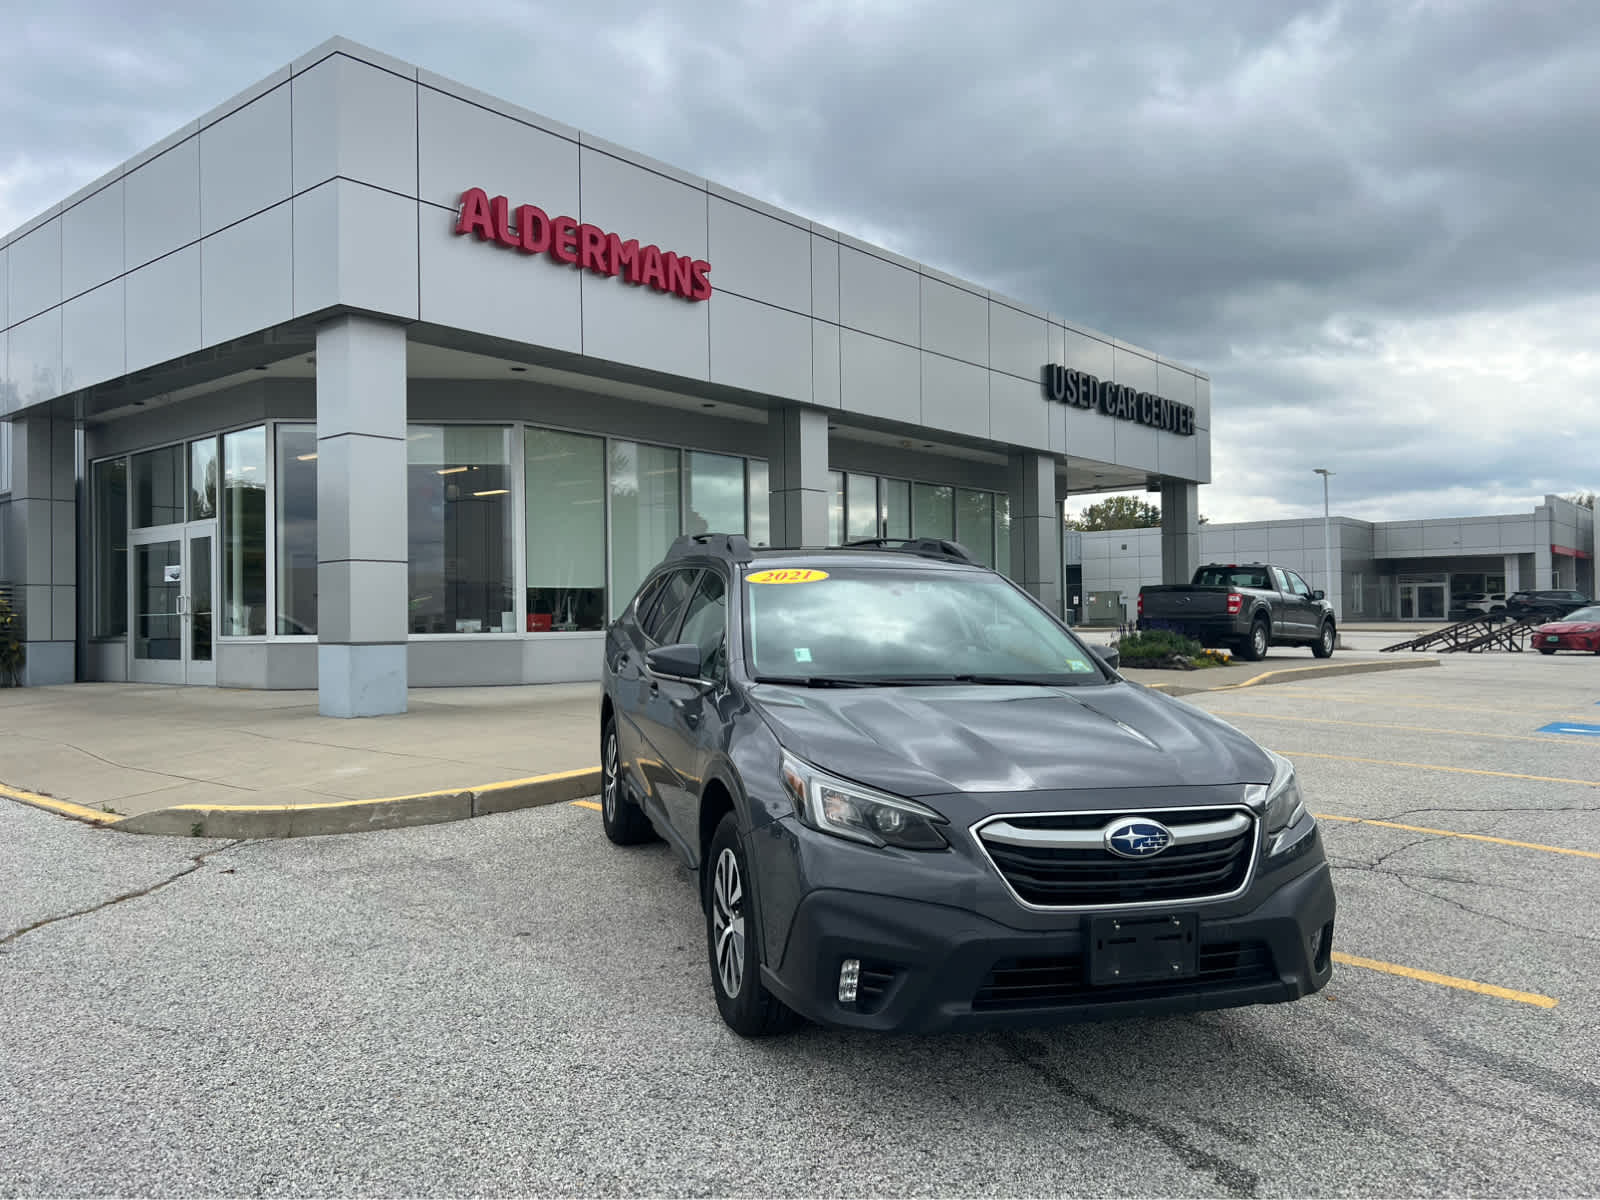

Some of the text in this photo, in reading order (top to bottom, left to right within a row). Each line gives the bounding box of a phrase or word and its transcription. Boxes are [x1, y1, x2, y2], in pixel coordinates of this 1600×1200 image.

[456, 187, 711, 301] ALDERMANS
[1046, 364, 1195, 435] USED CAR CENTER
[761, 571, 812, 582] 2021
